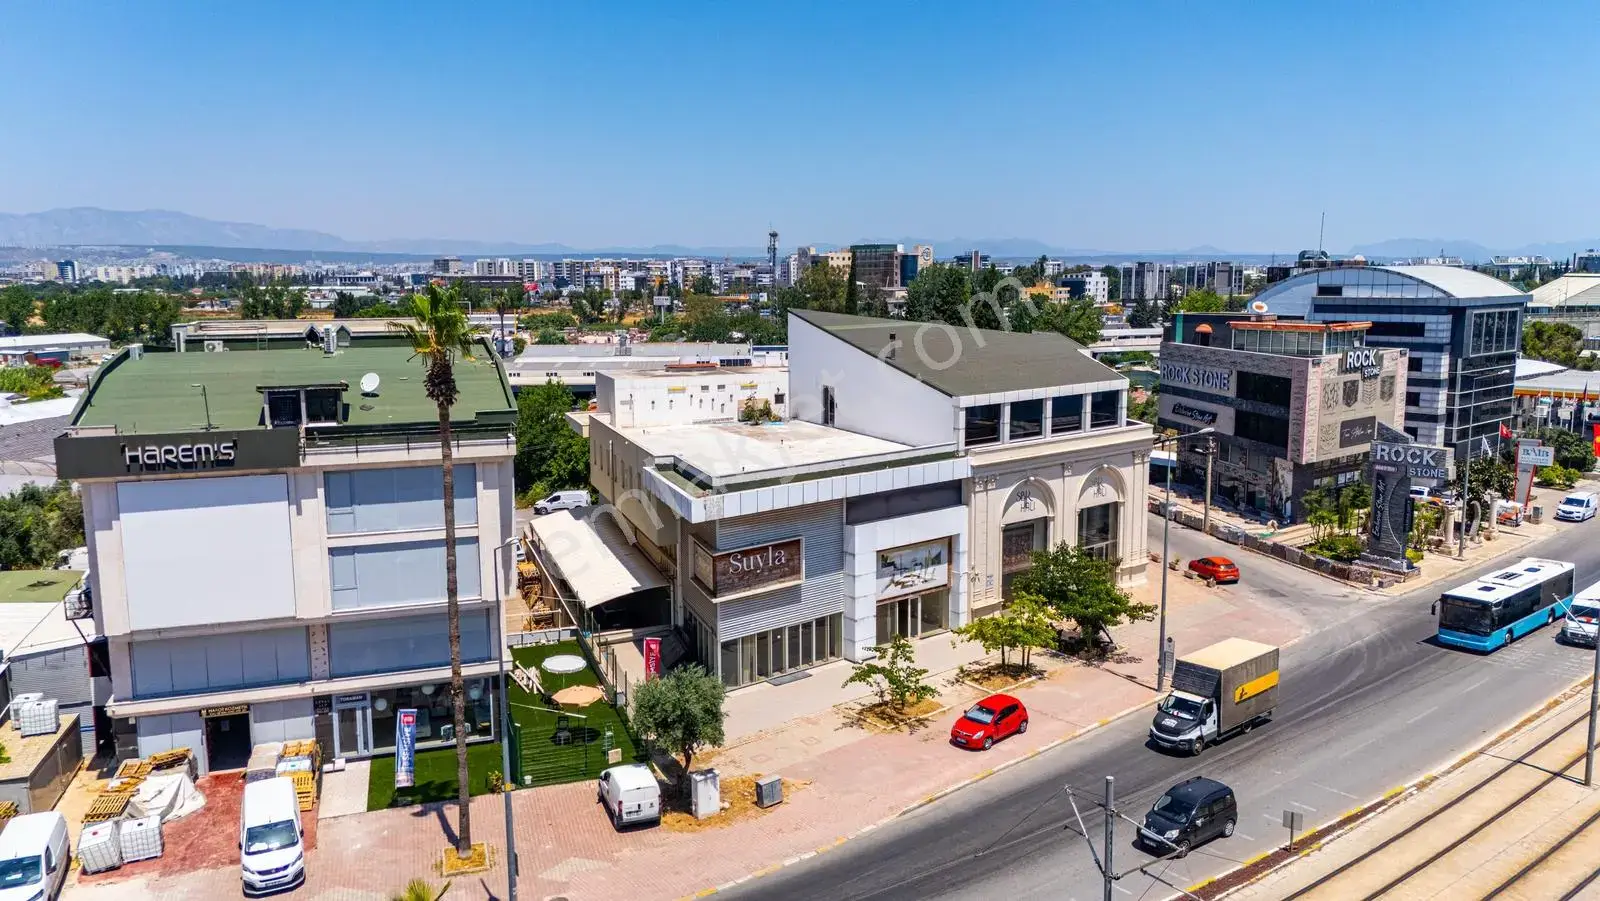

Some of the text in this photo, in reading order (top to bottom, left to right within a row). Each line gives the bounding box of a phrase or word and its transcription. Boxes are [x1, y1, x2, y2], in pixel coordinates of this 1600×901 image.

[1346, 348, 1377, 369] ROCK
[1161, 364, 1230, 390] ROCK STONE
[1364, 366, 1381, 378] STONE
[1376, 444, 1438, 466] ROCK
[1409, 467, 1445, 478] STONE
[729, 546, 787, 574] Suyla
